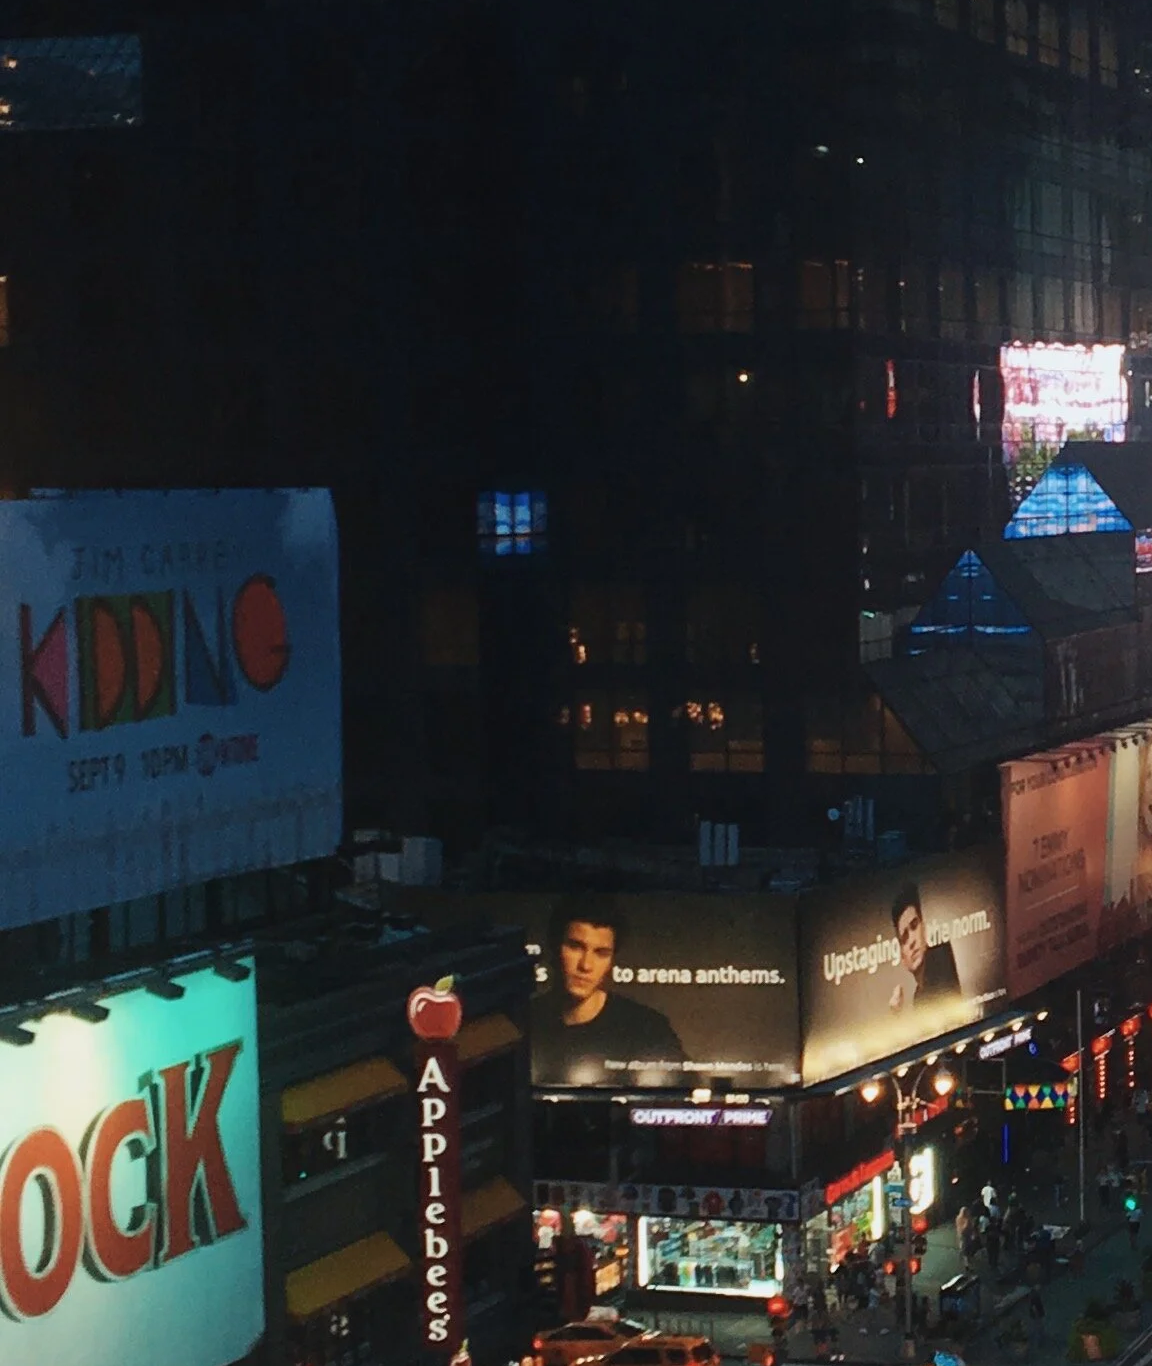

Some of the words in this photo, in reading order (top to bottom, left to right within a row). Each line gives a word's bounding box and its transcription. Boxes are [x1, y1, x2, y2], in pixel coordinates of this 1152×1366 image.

[823, 934, 901, 985] Upstaging
[926, 919, 950, 947] the
[951, 910, 991, 936] norm.
[612, 965, 633, 983] to
[637, 967, 692, 984] arena
[695, 965, 786, 984] anthems.
[632, 1109, 715, 1125] OUTFRONT
[724, 1109, 769, 1125] PRIME
[0, 1038, 249, 1325] OCK
